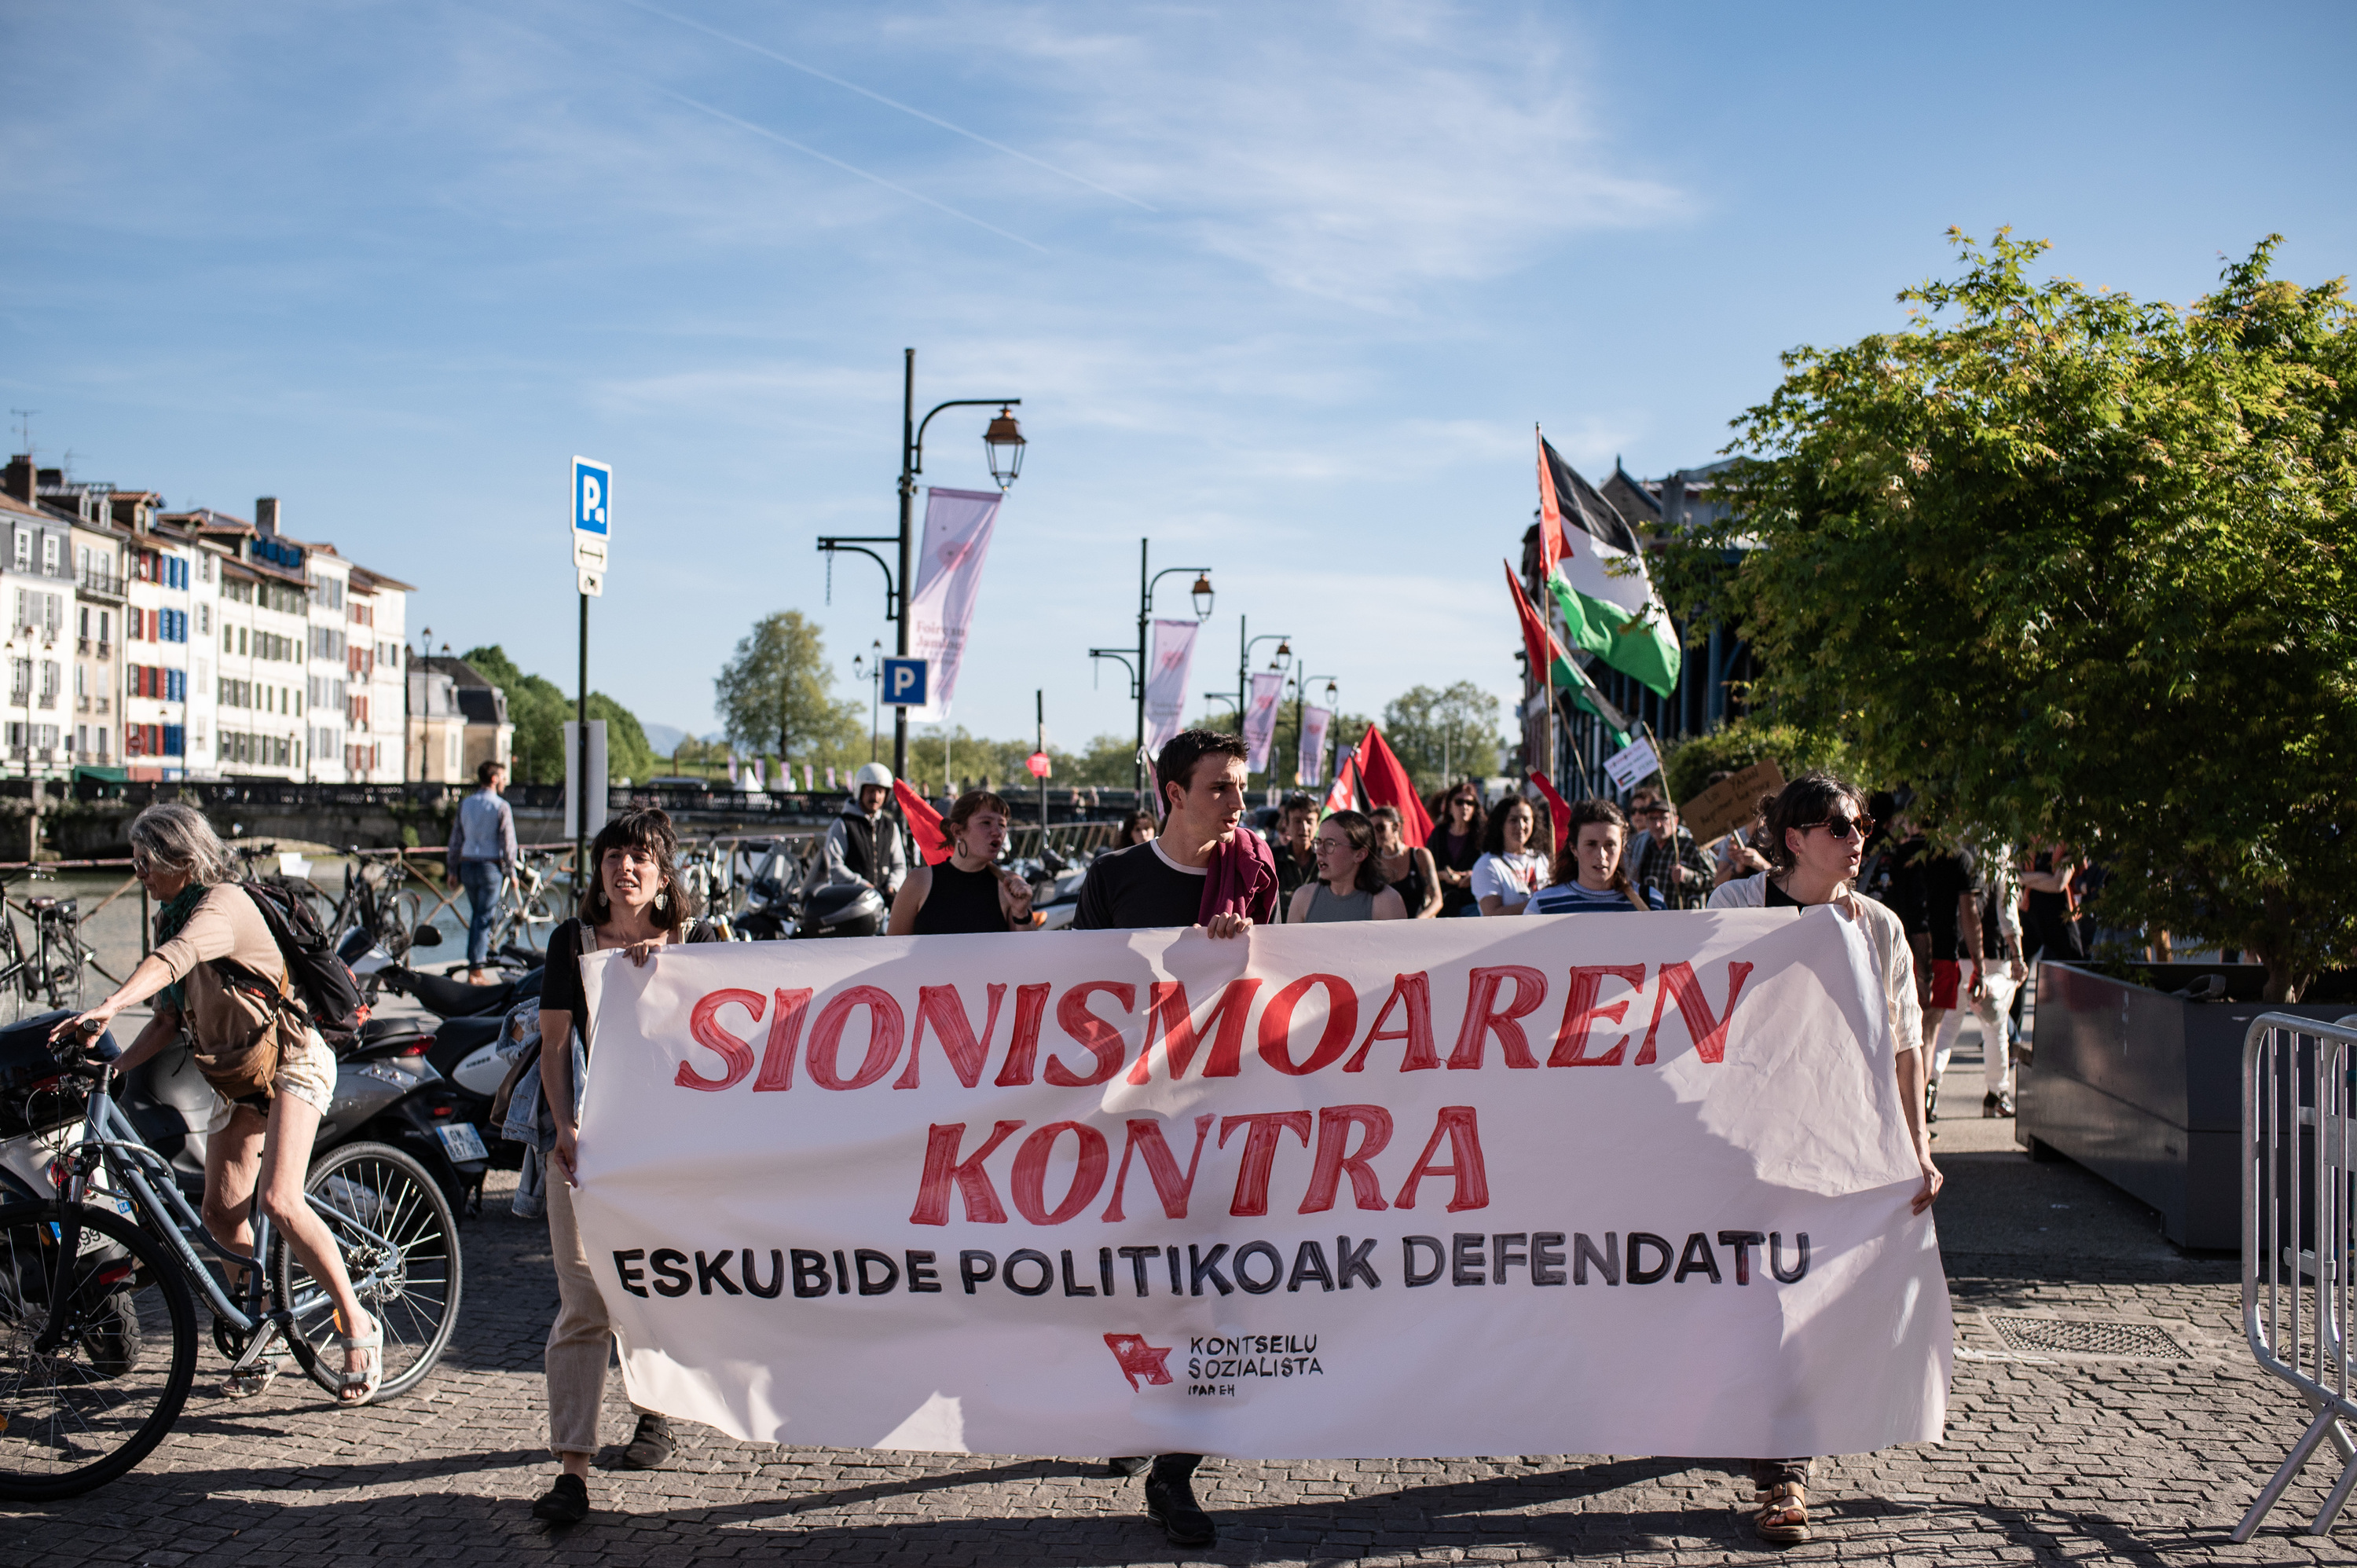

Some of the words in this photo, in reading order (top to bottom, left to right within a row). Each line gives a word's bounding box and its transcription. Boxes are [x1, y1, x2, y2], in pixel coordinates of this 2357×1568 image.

[894, 667, 915, 697] P
[674, 961, 1754, 1092] SIONISMOAREN
[909, 1105, 1490, 1227] KONTRA
[119, 1203, 129, 1212] 64
[179, 1238, 215, 1289] RIVERSIDE
[612, 1247, 943, 1299] ESKUBIDE
[960, 1235, 1382, 1297] POLITIKOAK
[1403, 1230, 1811, 1289] DEFENDATU
[1189, 1333, 1318, 1356] KONTSEILU
[1188, 1357, 1324, 1379] SOZIALISTA
[1188, 1385, 1216, 1397] IPAR
[1219, 1384, 1236, 1397] EH
